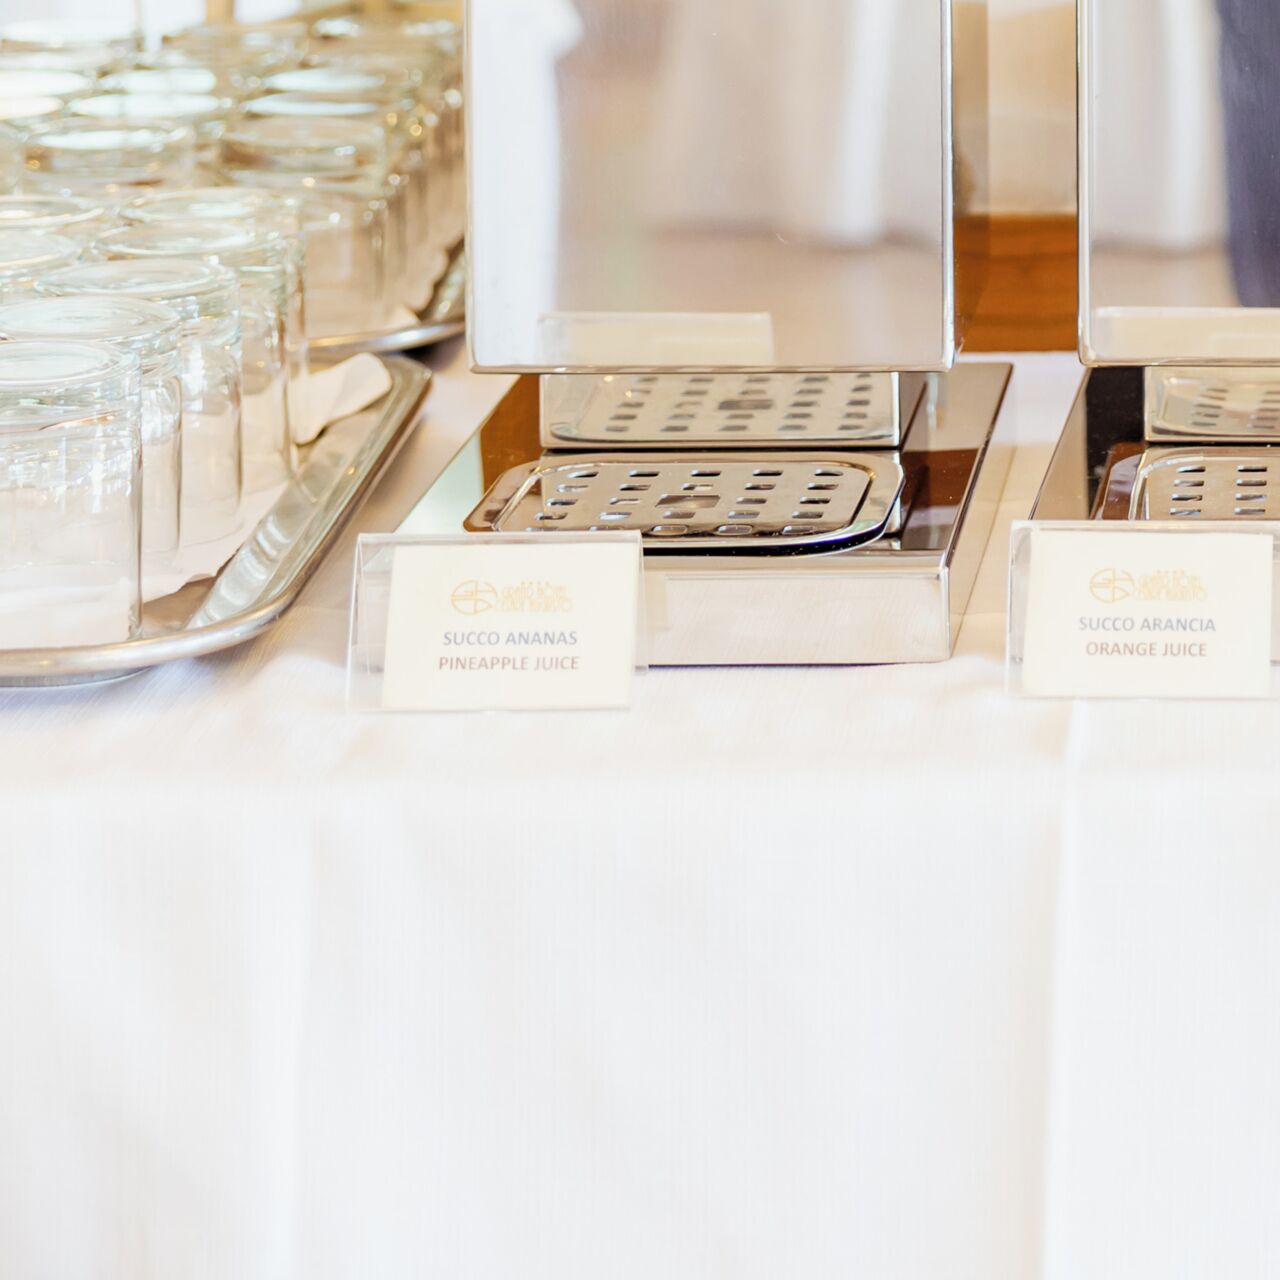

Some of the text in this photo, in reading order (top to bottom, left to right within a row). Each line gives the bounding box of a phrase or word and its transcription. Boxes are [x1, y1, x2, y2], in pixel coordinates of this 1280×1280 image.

[1078, 616, 1216, 633] SUCCO ARANCIA
[443, 631, 578, 646] SUCCO ANANAS
[1085, 641, 1208, 658] ORANGE JUICE
[438, 656, 580, 671] PINEAPPLE JUICE
